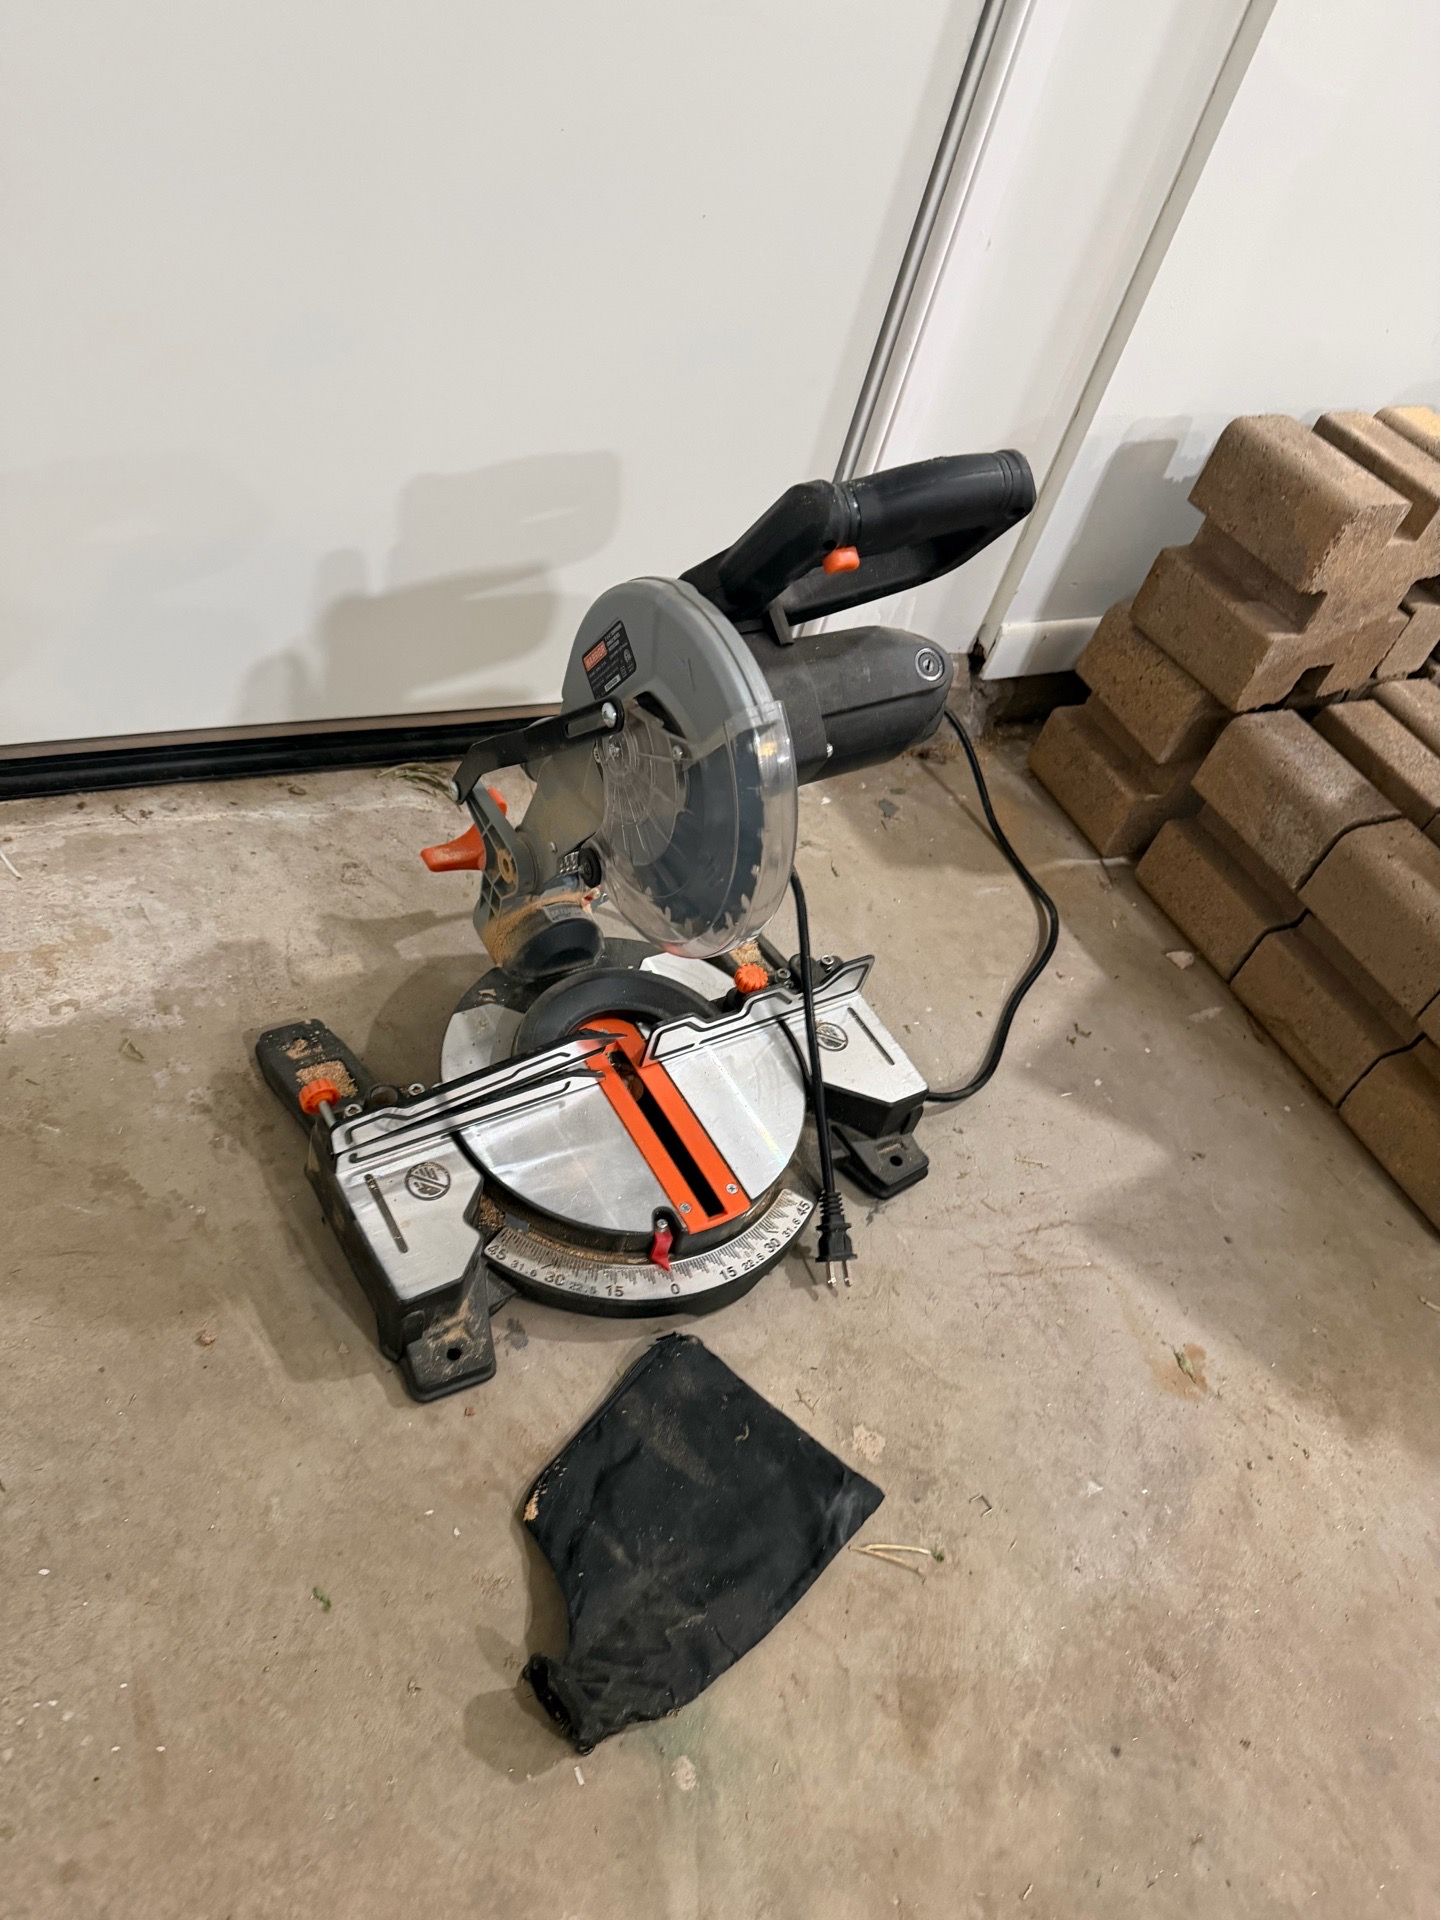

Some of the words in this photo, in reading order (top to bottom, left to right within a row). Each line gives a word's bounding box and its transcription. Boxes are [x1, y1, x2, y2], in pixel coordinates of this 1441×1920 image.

[488, 1244, 507, 1261] 45
[545, 1270, 566, 1287] 30
[605, 1284, 625, 1298] 15
[670, 1283, 681, 1295] 0
[719, 1266, 738, 1281] 15
[741, 1253, 766, 1272] 22.5
[763, 1238, 781, 1254] 30
[796, 1200, 811, 1216] 45
